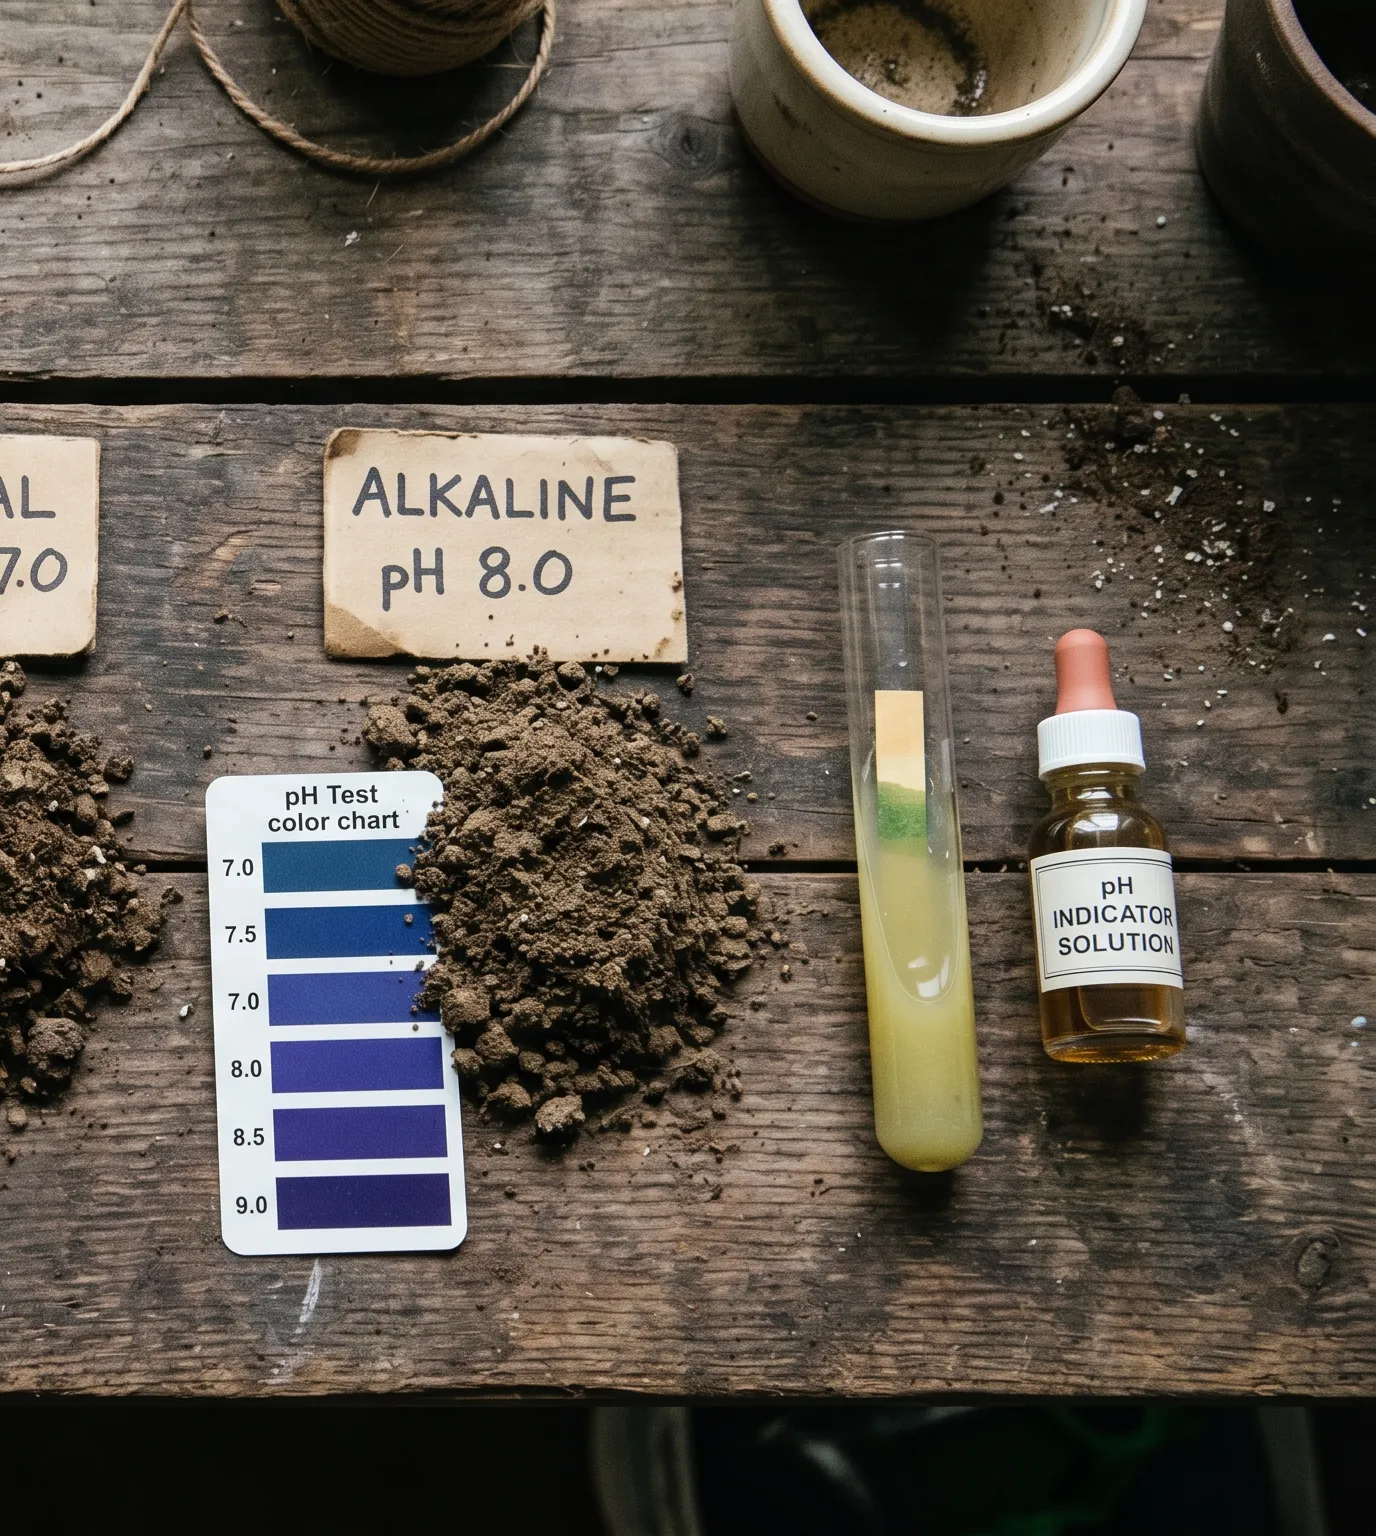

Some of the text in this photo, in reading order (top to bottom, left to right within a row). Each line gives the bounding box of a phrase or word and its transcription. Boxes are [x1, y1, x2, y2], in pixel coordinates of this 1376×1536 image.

[352, 467, 636, 522] ALKALINE
[382, 546, 573, 612] pH 8.0
[286, 785, 378, 810] pH Test
[269, 811, 399, 832] color chart
[223, 859, 253, 876] 7.0
[1102, 877, 1132, 899] pH
[1054, 905, 1173, 928] INDICATOR
[225, 926, 256, 943] 7.5
[1059, 933, 1173, 955] SOLUTION
[229, 993, 259, 1010] 7.0
[232, 1060, 261, 1078] 8.0
[234, 1128, 264, 1146] 8.5
[236, 1196, 267, 1214] 9.0
